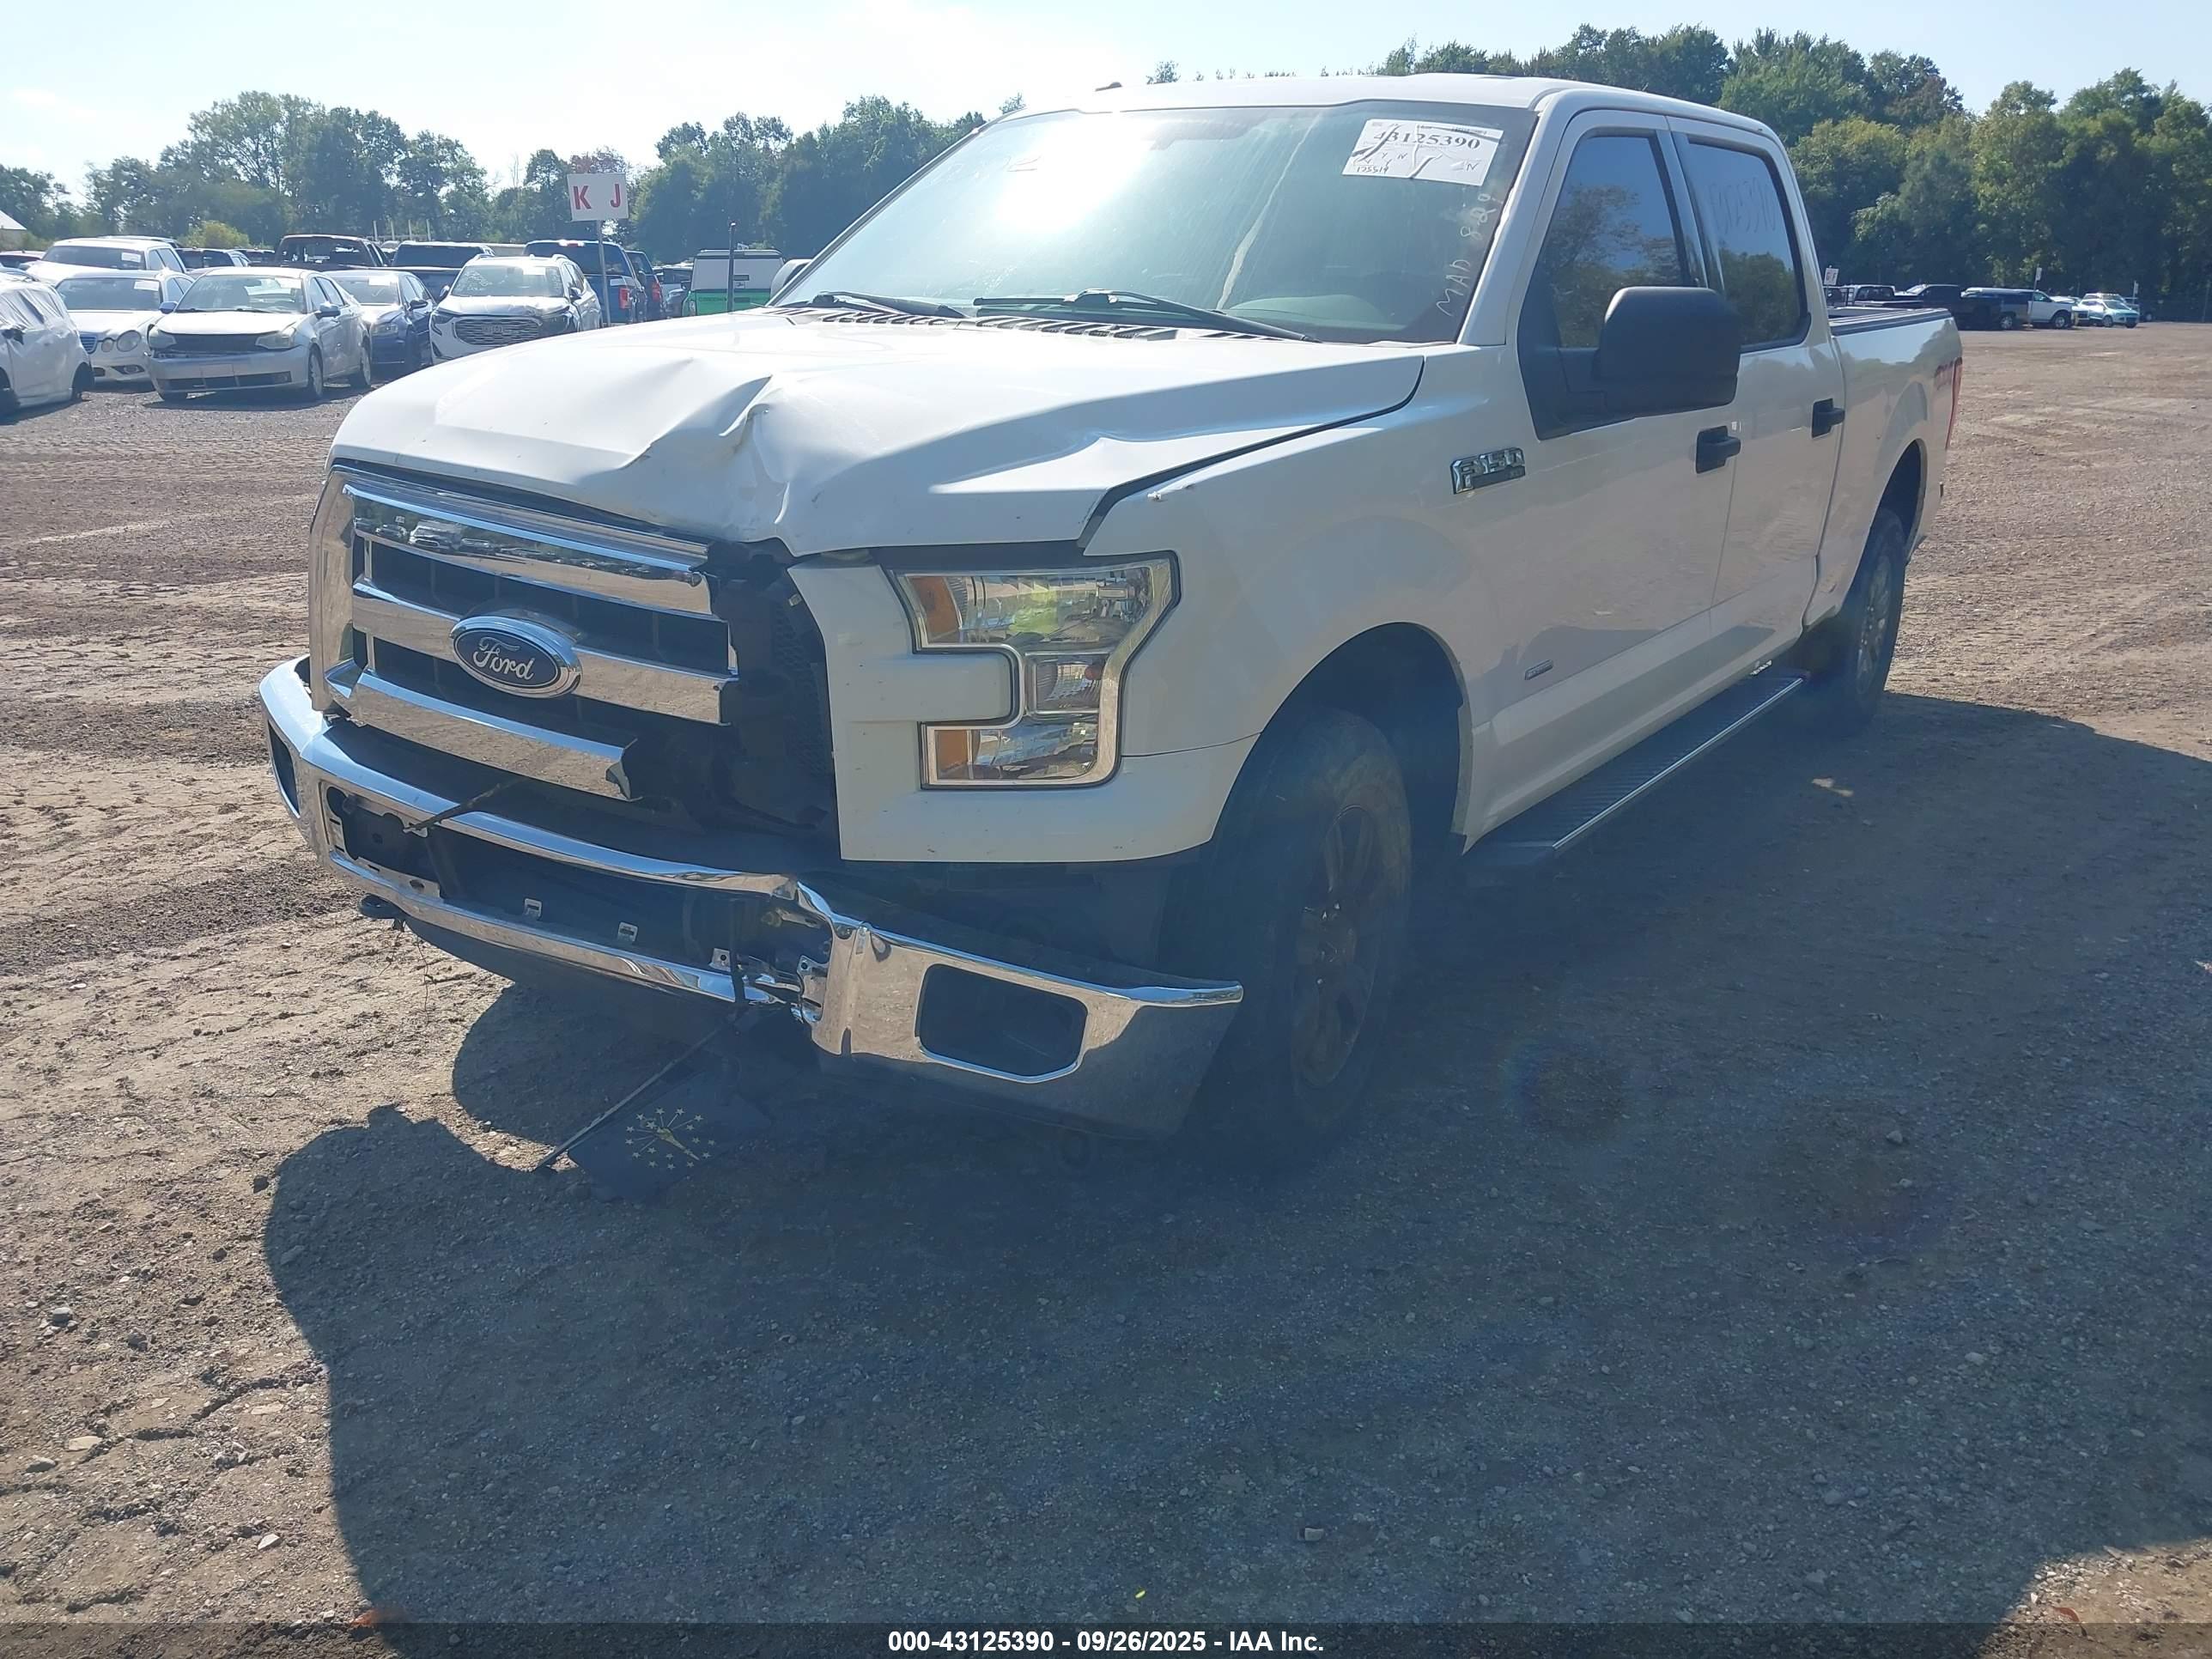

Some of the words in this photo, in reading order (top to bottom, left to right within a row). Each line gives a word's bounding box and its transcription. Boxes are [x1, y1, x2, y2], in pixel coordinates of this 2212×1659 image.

[1374, 131, 1480, 149] 43125390
[573, 185, 592, 210] K
[610, 183, 621, 208] J
[1436, 259, 1471, 317] MAD
[473, 636, 535, 680] Ford
